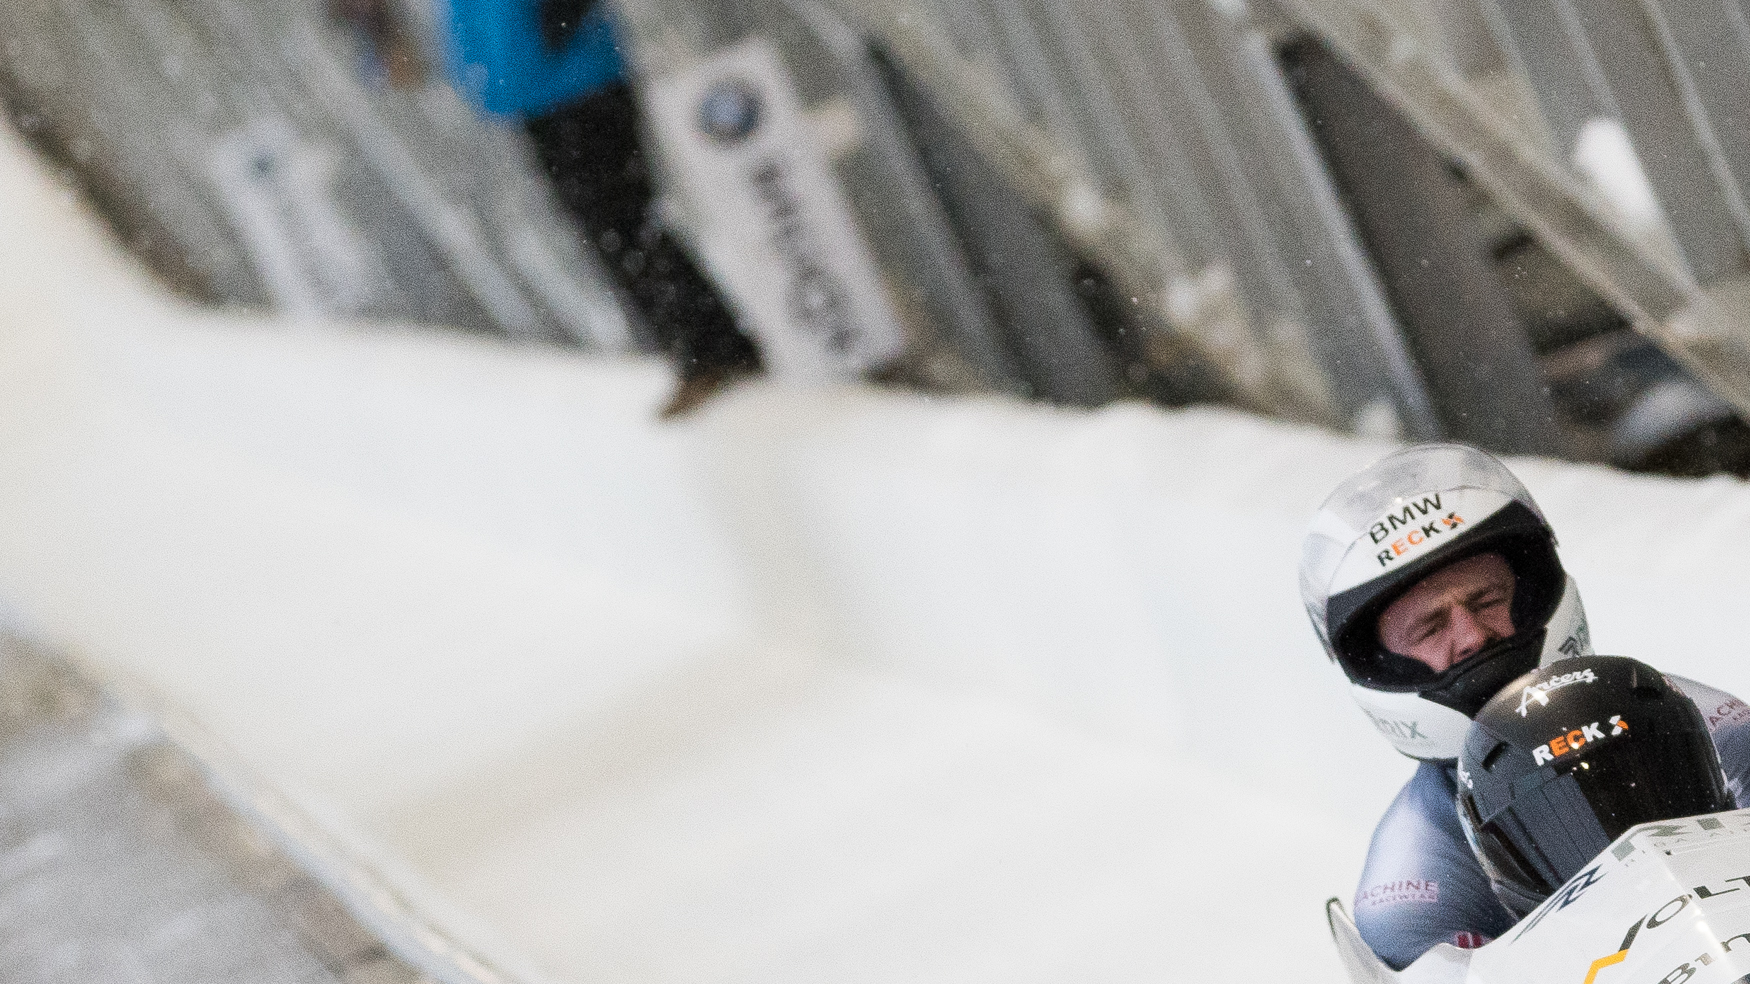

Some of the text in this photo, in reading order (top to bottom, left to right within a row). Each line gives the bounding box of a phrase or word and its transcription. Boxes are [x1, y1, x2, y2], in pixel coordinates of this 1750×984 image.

[1370, 493, 1441, 544] BMW
[1378, 521, 1441, 567] RECK
[1532, 722, 1606, 766] RECK
